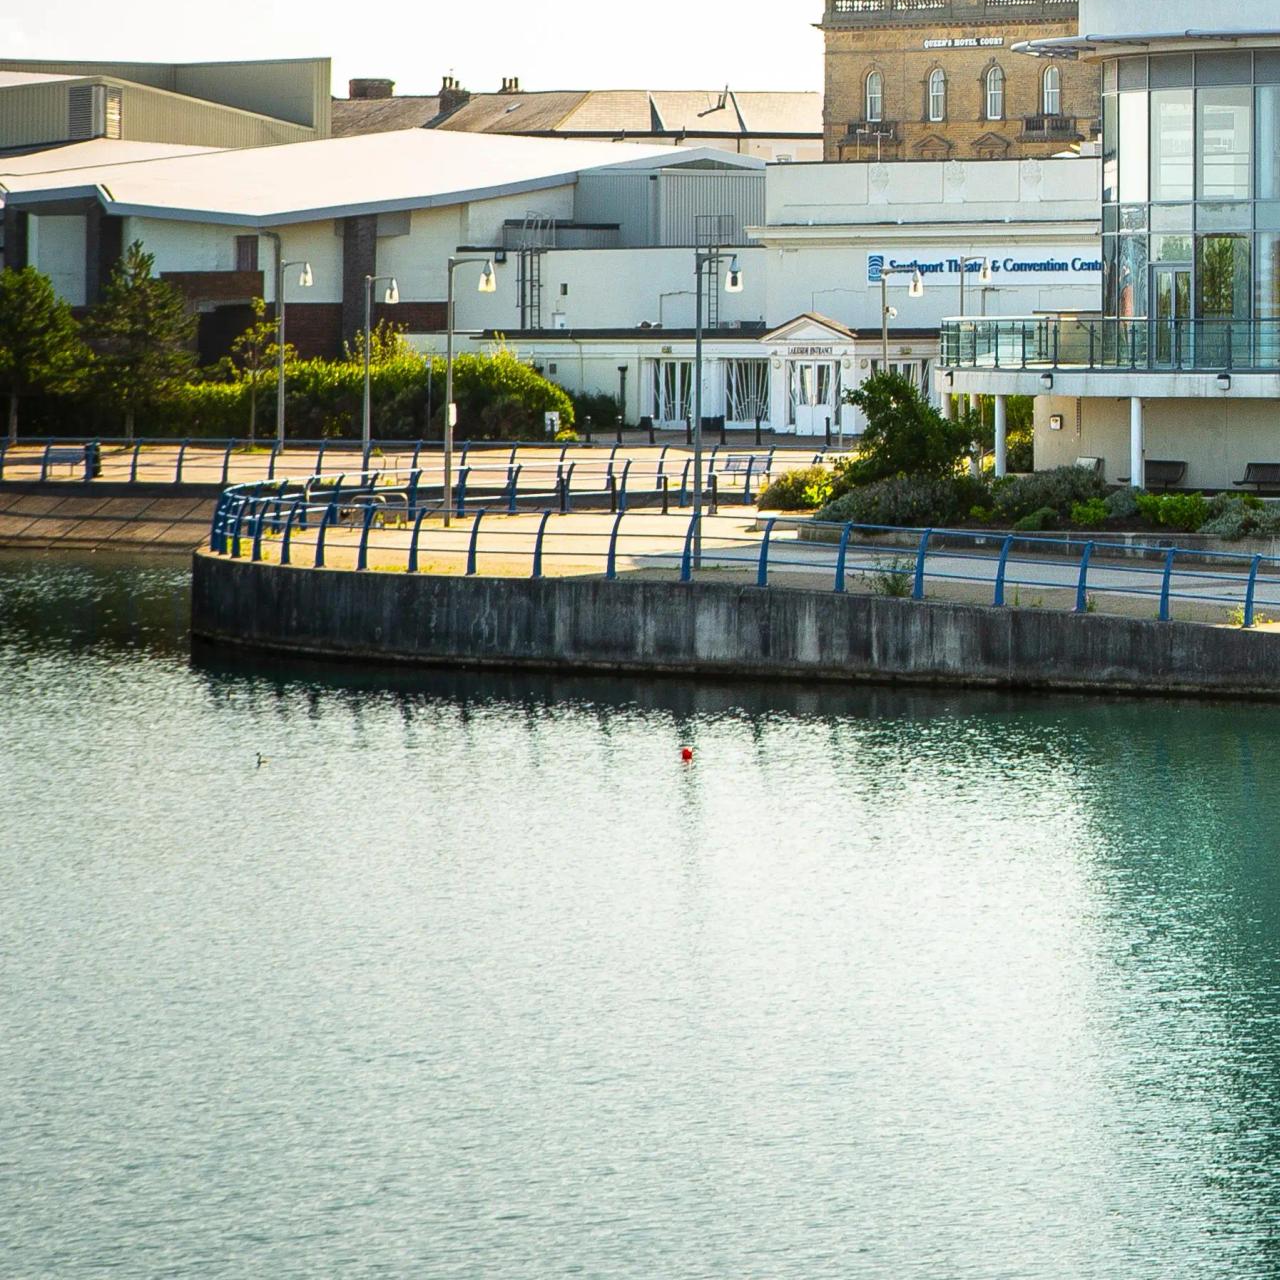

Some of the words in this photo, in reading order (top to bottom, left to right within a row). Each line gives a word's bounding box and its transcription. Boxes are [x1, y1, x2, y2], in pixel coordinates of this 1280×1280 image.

[954, 38, 978, 47] HOTEL
[980, 37, 1003, 45] COURT
[945, 259, 988, 273] Theatr
[990, 260, 1001, 272] &
[1003, 258, 1069, 272] Convention
